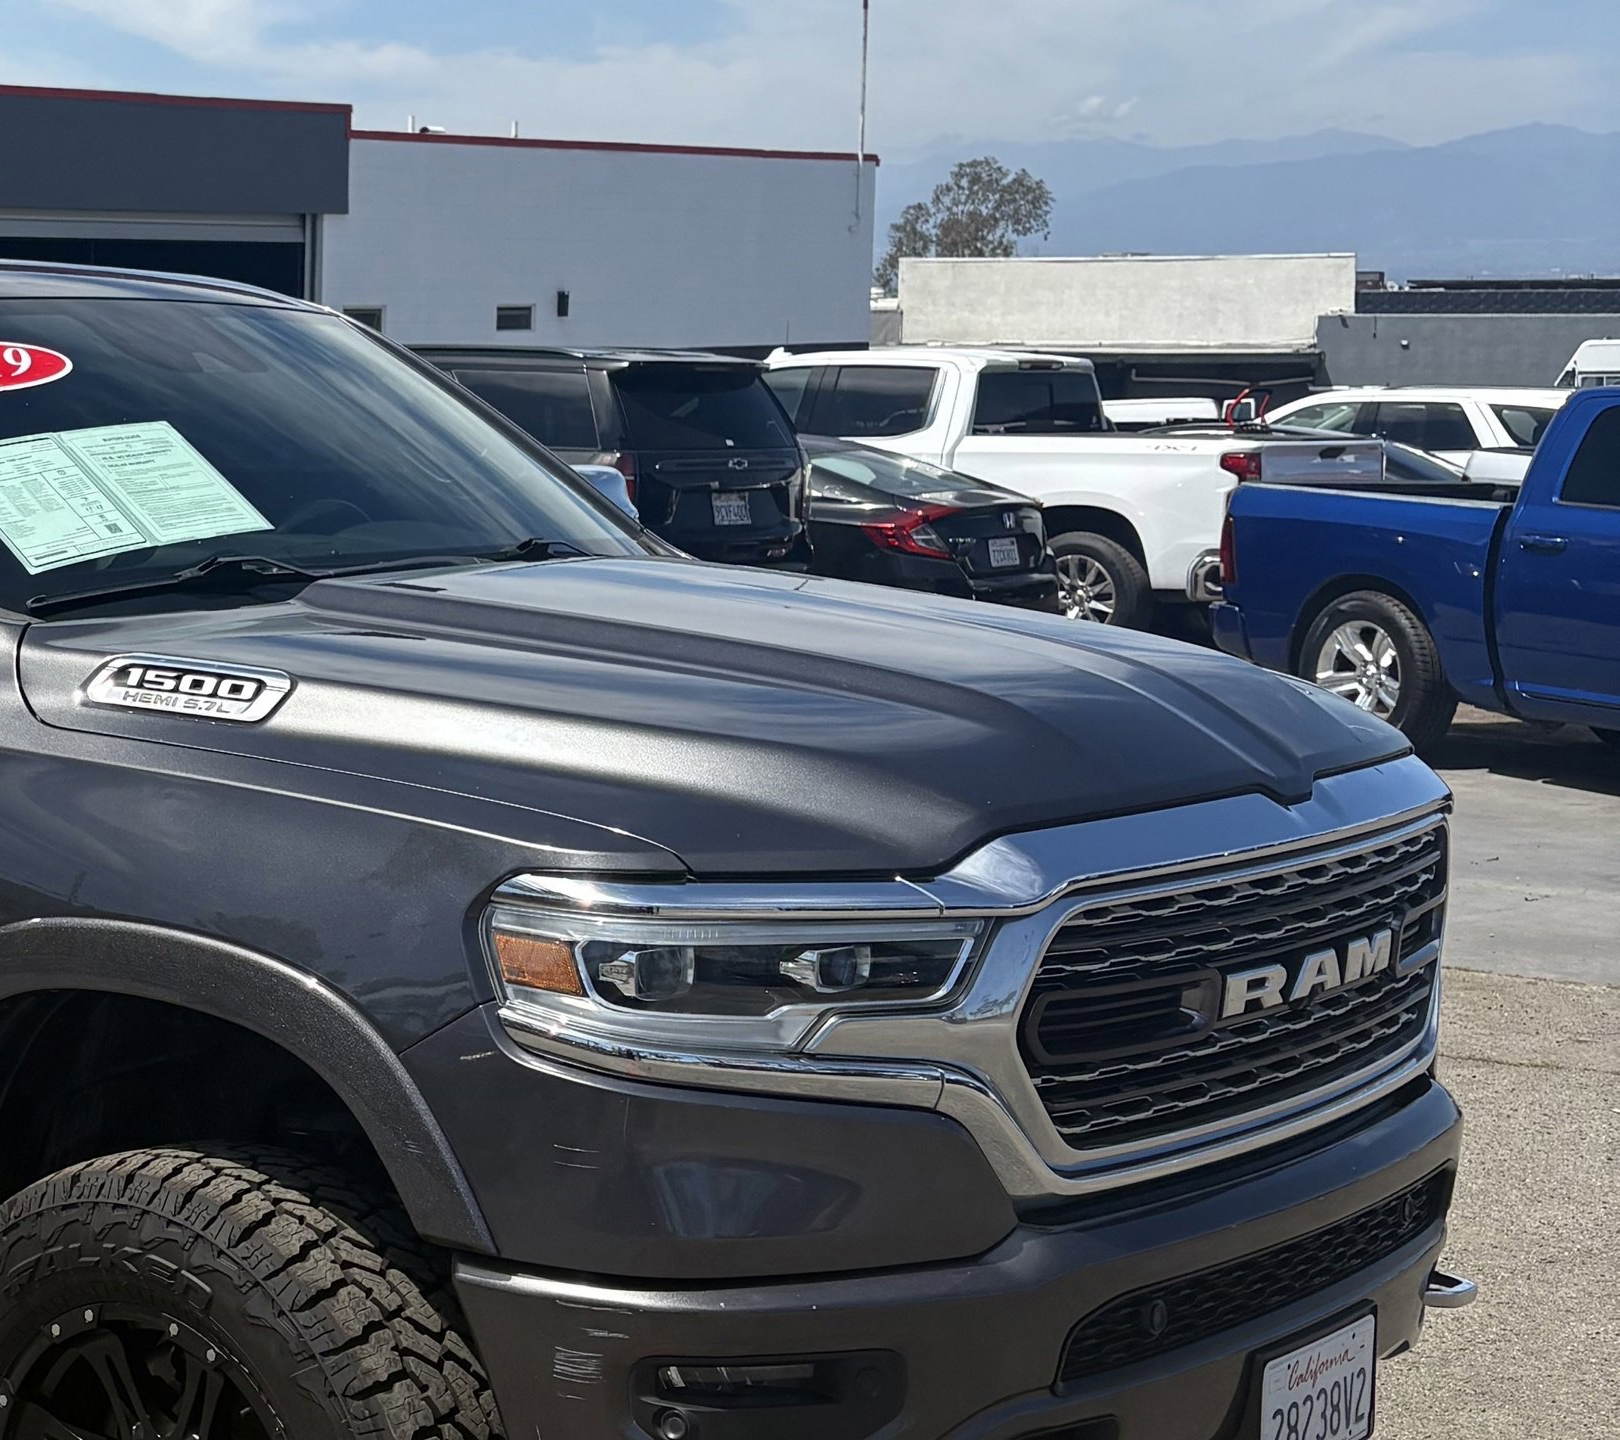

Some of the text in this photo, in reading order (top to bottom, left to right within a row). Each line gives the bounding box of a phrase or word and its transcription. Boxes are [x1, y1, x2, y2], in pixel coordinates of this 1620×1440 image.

[122, 690, 232, 714] HEMI 5.7L
[125, 667, 261, 701] 1500
[1222, 928, 1392, 1019] RAM
[3, 1242, 214, 1312] FALKEN
[1288, 1349, 1355, 1391] California
